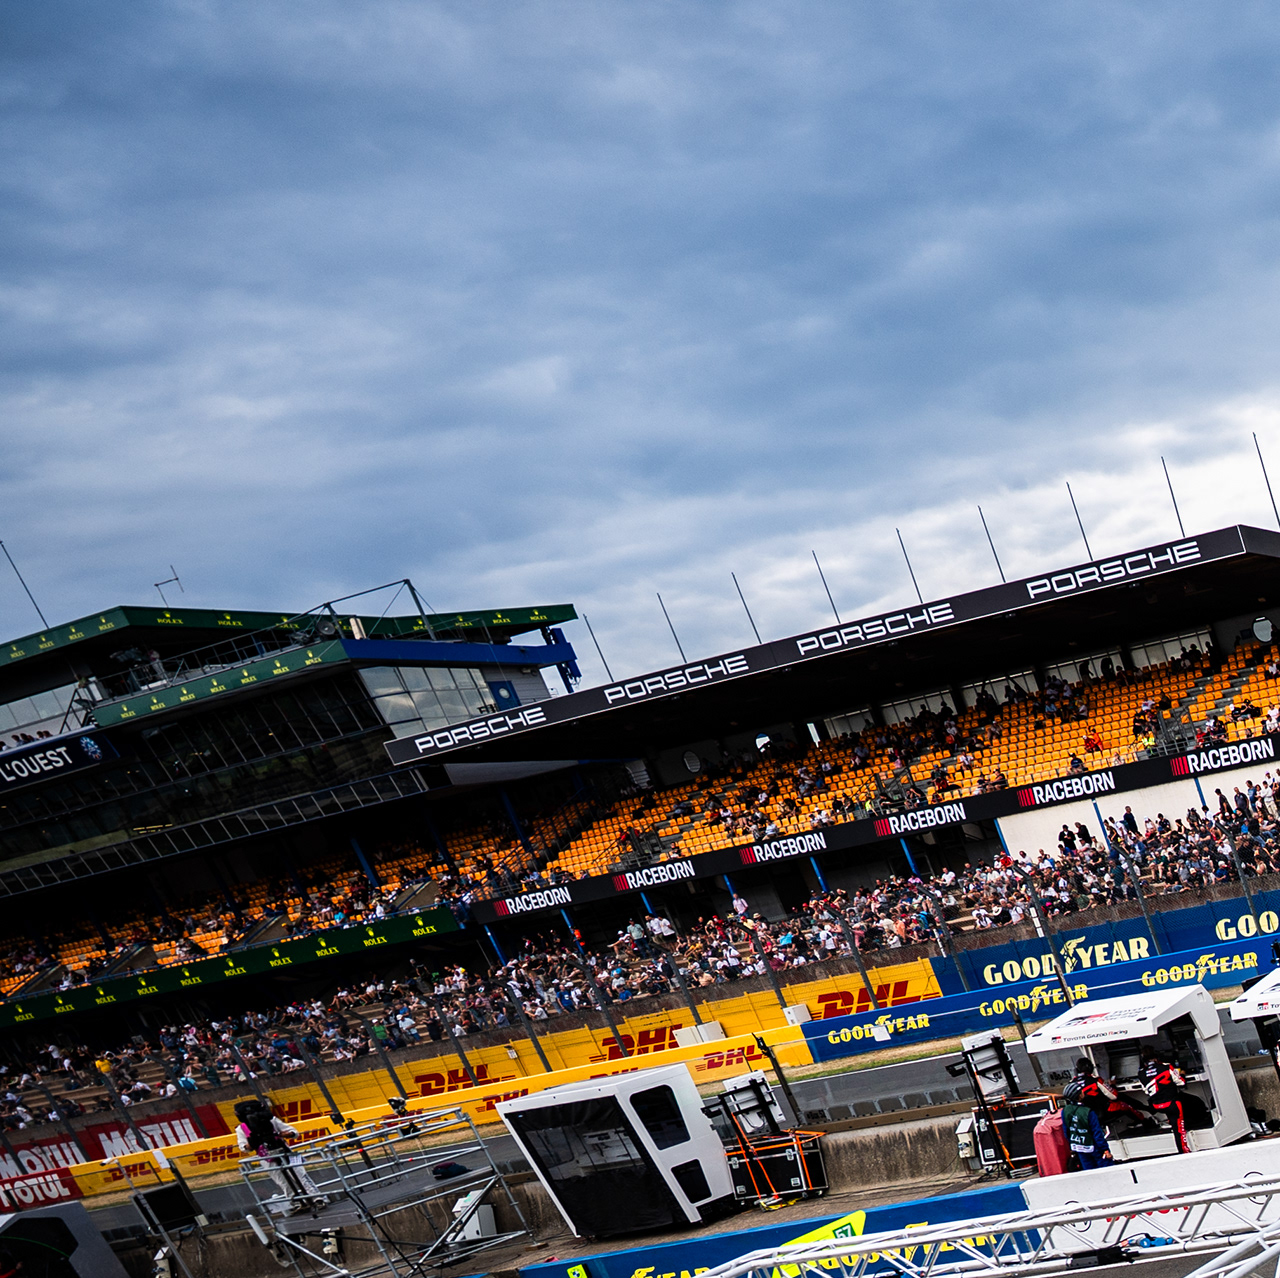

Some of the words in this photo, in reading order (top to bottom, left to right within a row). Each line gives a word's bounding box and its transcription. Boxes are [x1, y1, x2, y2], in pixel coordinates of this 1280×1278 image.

[1027, 540, 1201, 599] PORSCHE
[796, 603, 955, 656] PORSCHE
[604, 655, 750, 704] PORSCHE
[414, 707, 547, 753] PORSCHE
[0, 747, 74, 782] L'OUEST
[1187, 739, 1275, 773] RACEBORN
[1033, 771, 1116, 805] RACEBORN
[889, 802, 966, 833] RACEBORN
[753, 832, 827, 862] RACEBORN
[626, 860, 695, 889] RACEBORN
[506, 886, 572, 915] RACEBORN
[363, 935, 388, 947] ROLEX
[412, 925, 437, 937] ROLEX
[269, 956, 293, 967] ROLEX
[316, 946, 339, 957] ROLEX
[984, 936, 1149, 984] GOODYEAR
[180, 976, 202, 986] ROLEX
[224, 966, 247, 977] ROLEX
[1142, 952, 1258, 987] GOODYEAR
[95, 995, 117, 1005] ROLEX
[137, 985, 158, 996] ROLEX
[980, 984, 1088, 1016] GOODYEAR
[14, 1012, 35, 1022] ROLEX
[54, 1004, 75, 1014] ROLEX
[1063, 1034, 1086, 1042] TOYOTA
[1109, 1029, 1128, 1037] Racing
